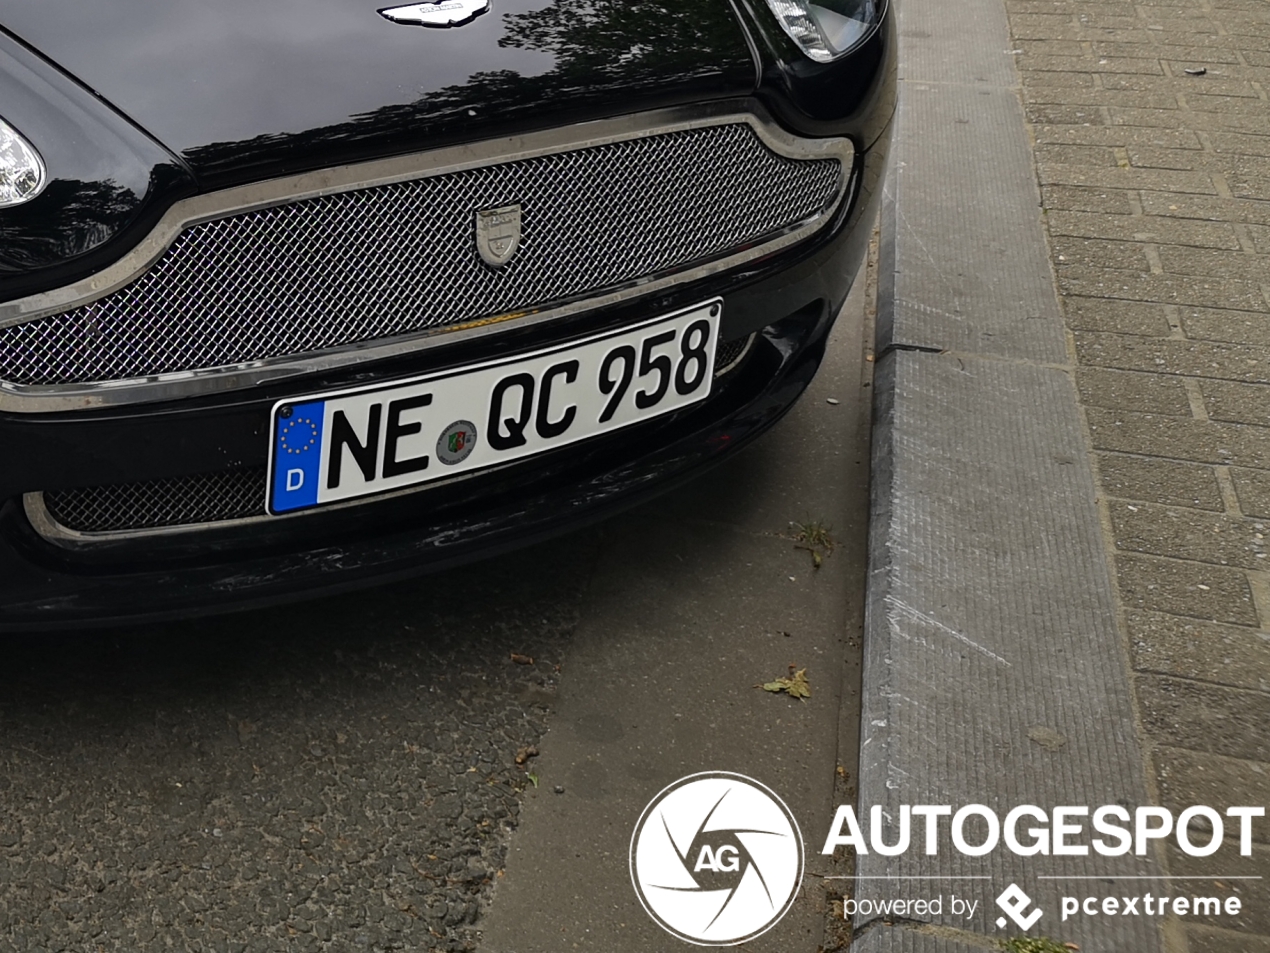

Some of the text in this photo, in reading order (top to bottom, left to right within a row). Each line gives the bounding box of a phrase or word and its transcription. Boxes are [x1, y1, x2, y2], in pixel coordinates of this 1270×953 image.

[326, 393, 433, 490] NE
[486, 359, 580, 452] QC
[598, 319, 711, 424] 958
[286, 468, 304, 492] D
